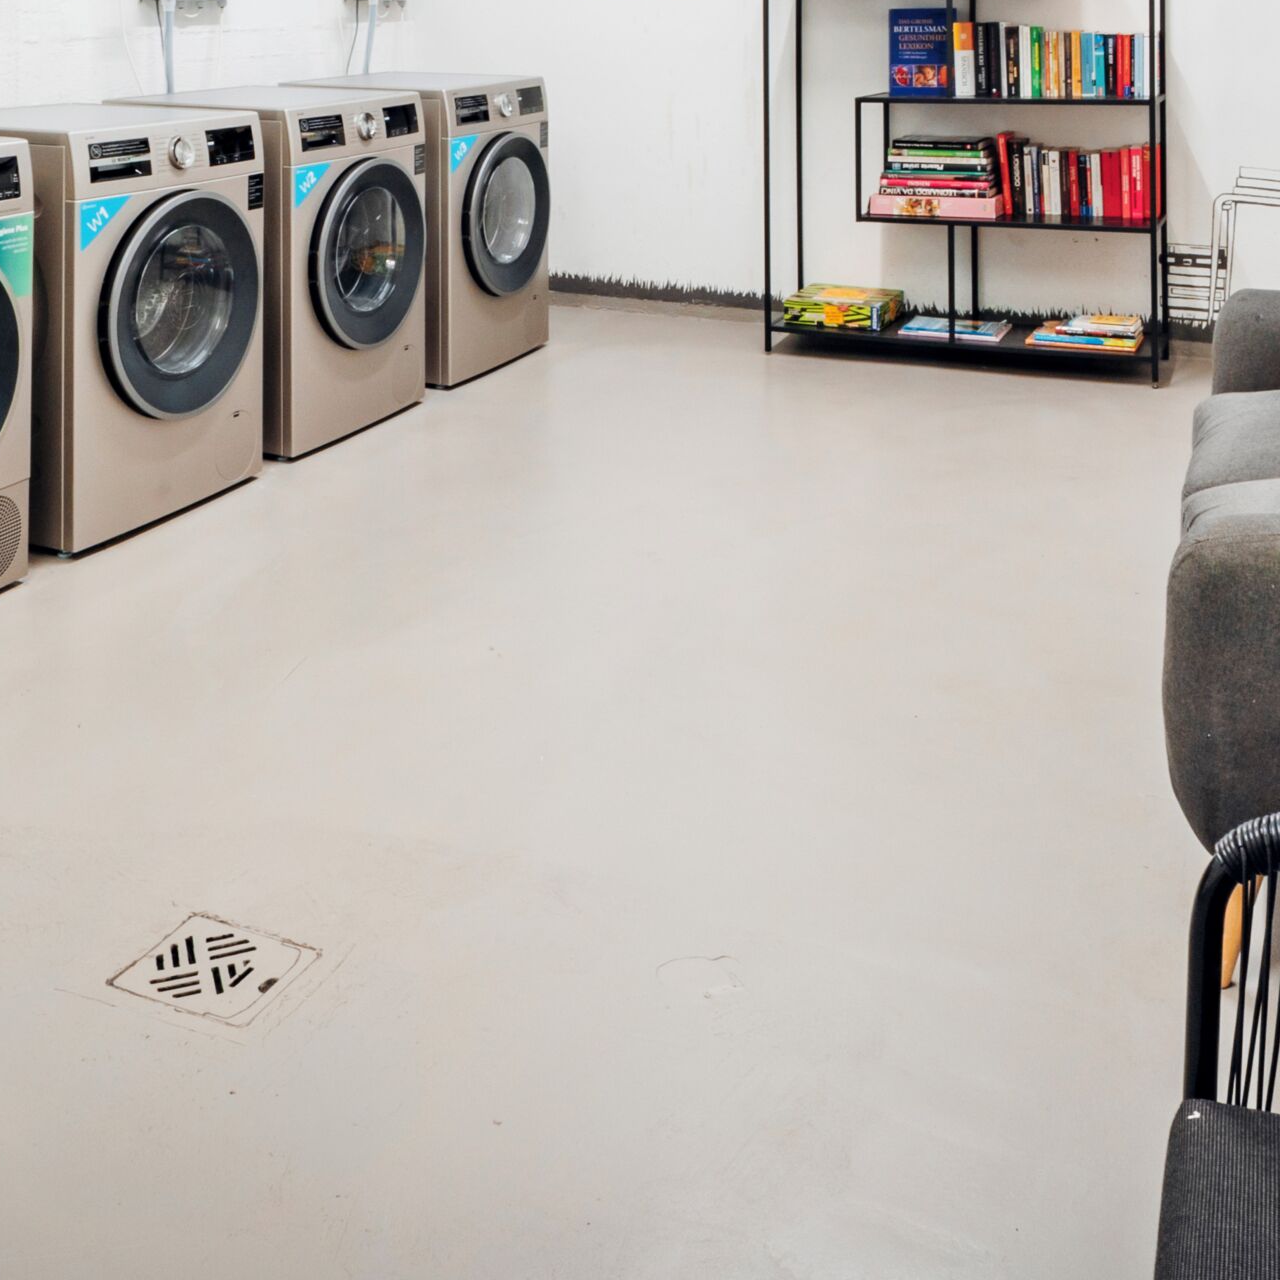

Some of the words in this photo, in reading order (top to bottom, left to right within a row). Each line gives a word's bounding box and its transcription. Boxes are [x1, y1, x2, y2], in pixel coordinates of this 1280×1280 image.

[298, 170, 318, 194] W2
[915, 188, 958, 197] LEONARDO
[86, 205, 110, 233] W1
